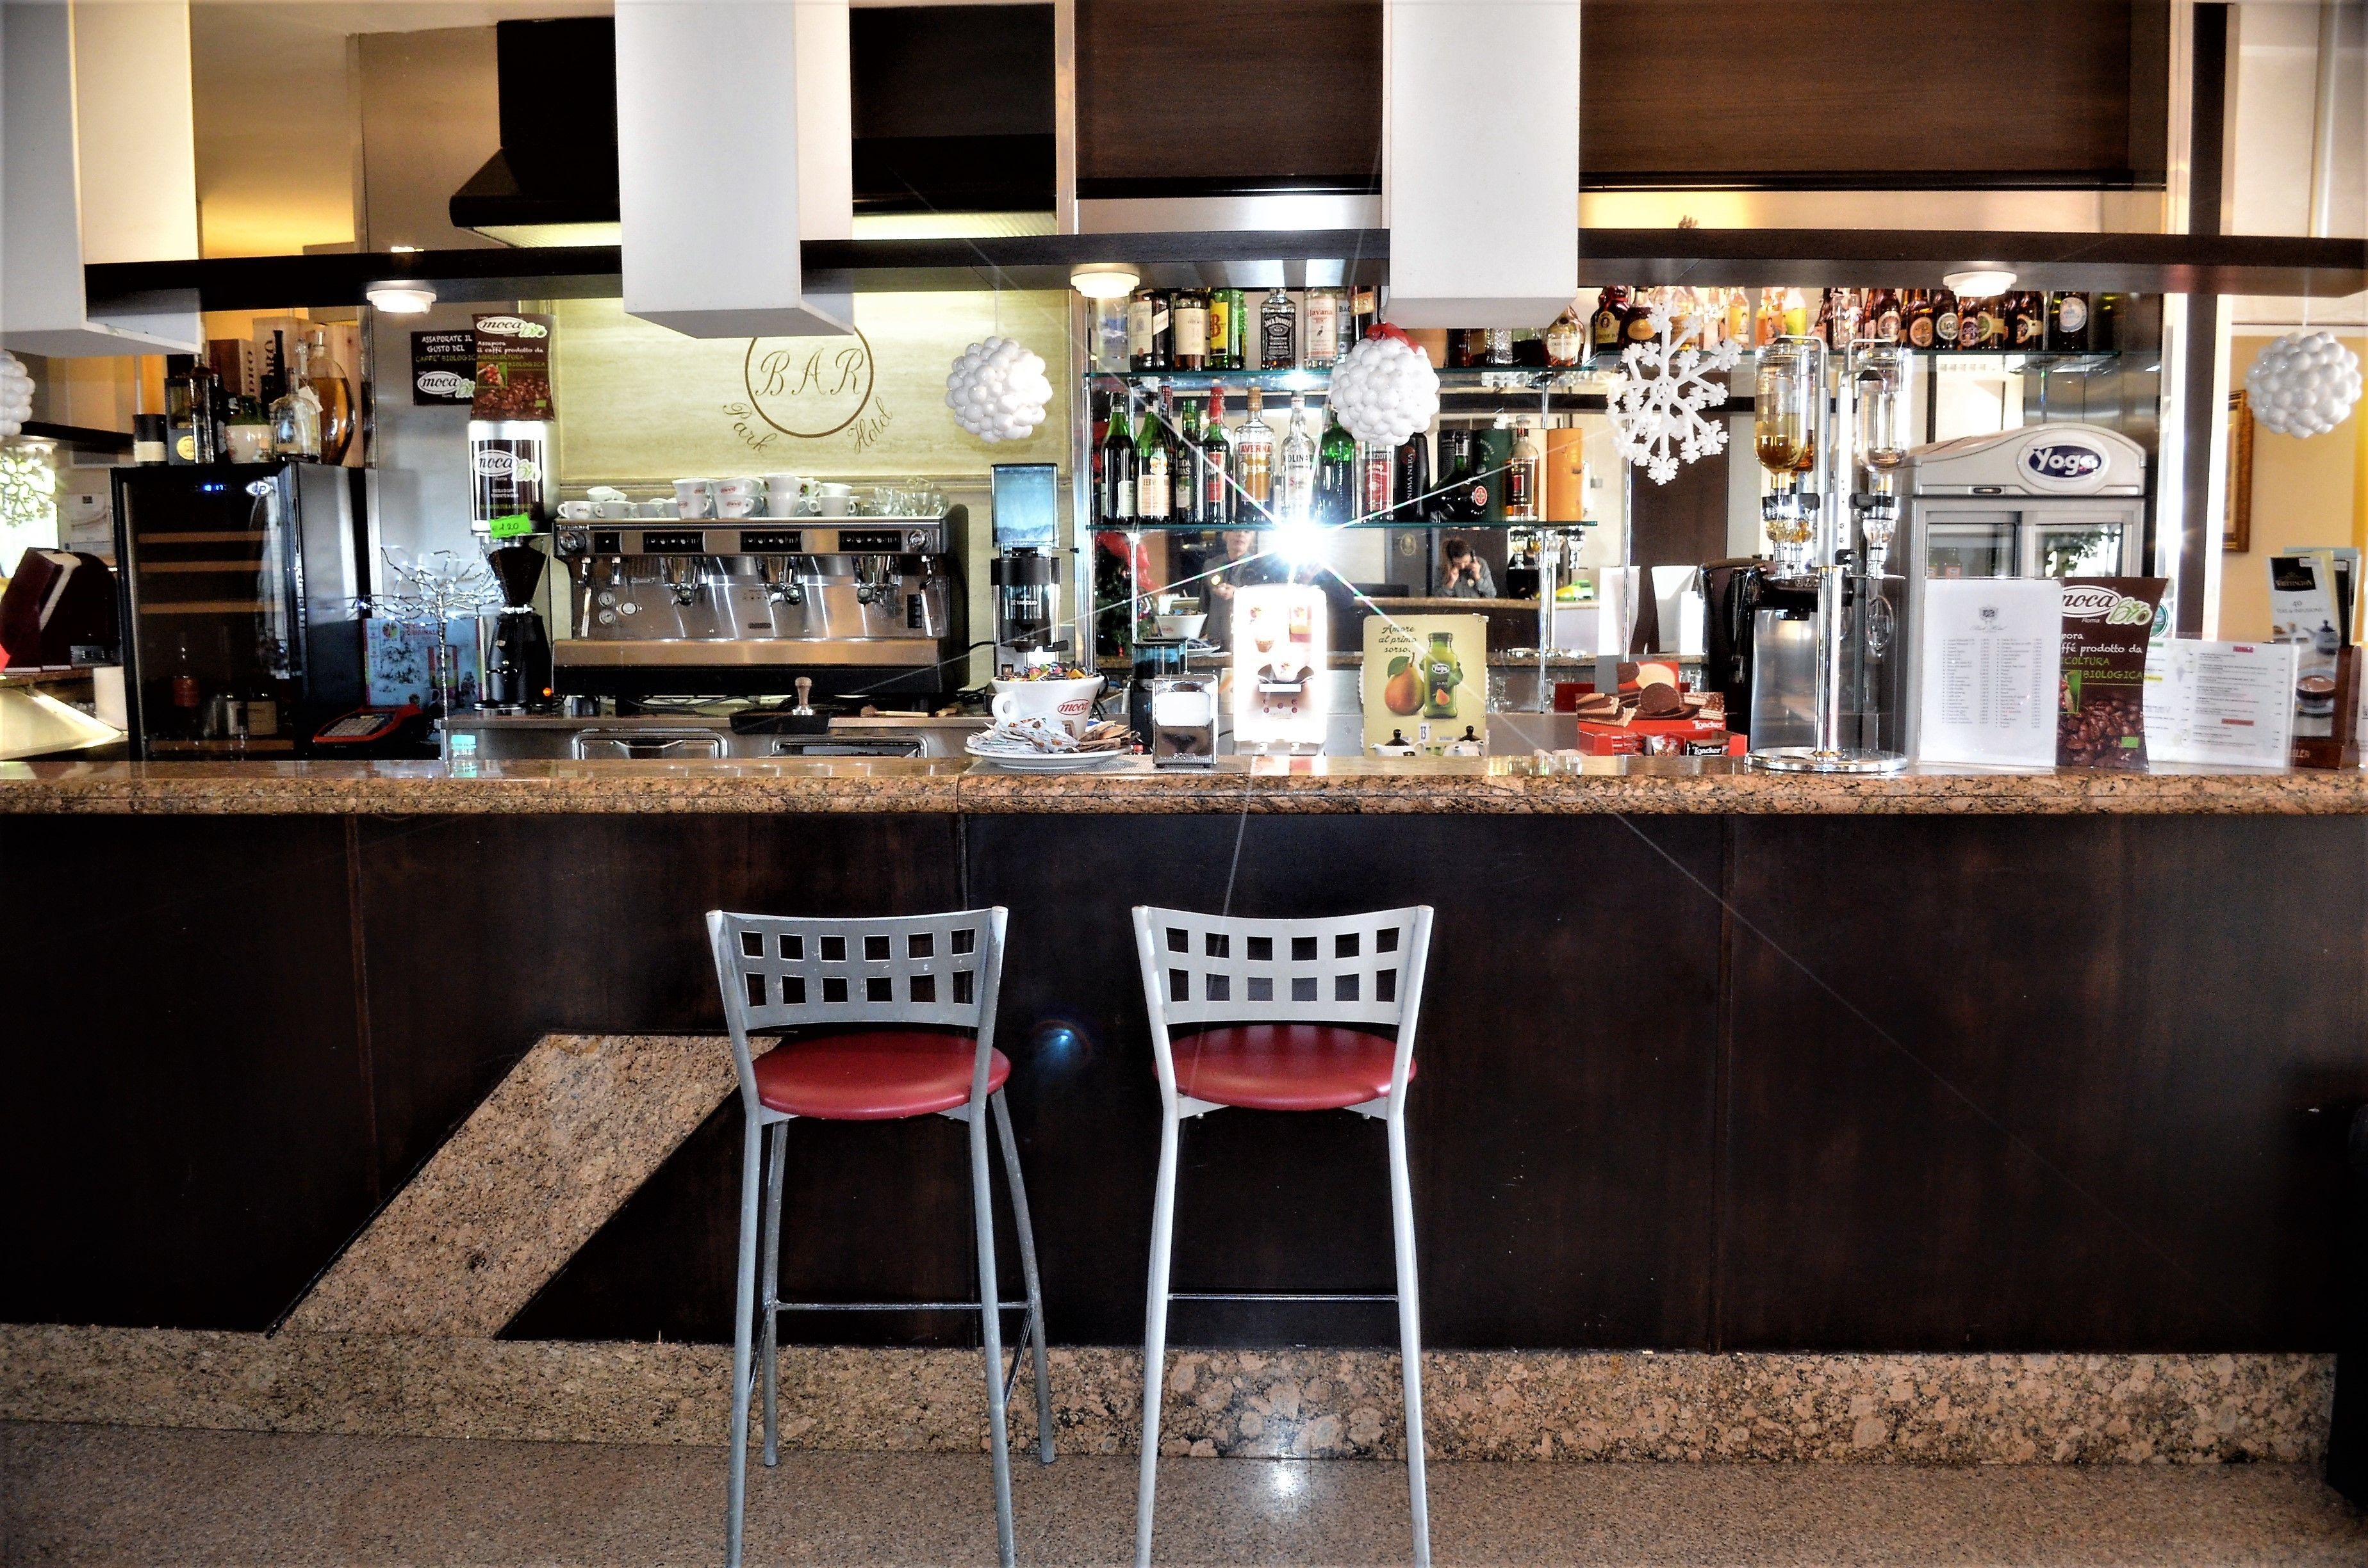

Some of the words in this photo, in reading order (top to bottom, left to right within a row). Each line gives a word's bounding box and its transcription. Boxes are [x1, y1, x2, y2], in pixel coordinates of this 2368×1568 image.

[482, 320, 522, 329] moca
[422, 335, 462, 343] ASSAPORATE
[755, 348, 864, 396] BAR
[422, 377, 457, 387] moca
[723, 402, 777, 452] Park
[847, 396, 892, 454] Hotel
[1240, 444, 1272, 453] AVERNA
[1378, 634, 1388, 643] al
[2080, 643, 2125, 657] prodotto
[2129, 644, 2142, 654] da
[2084, 669, 2144, 679] BIOLOGICA
[1060, 701, 1089, 712] moca
[1692, 720, 1724, 730] Loacker
[1692, 746, 1722, 756] Loacker
